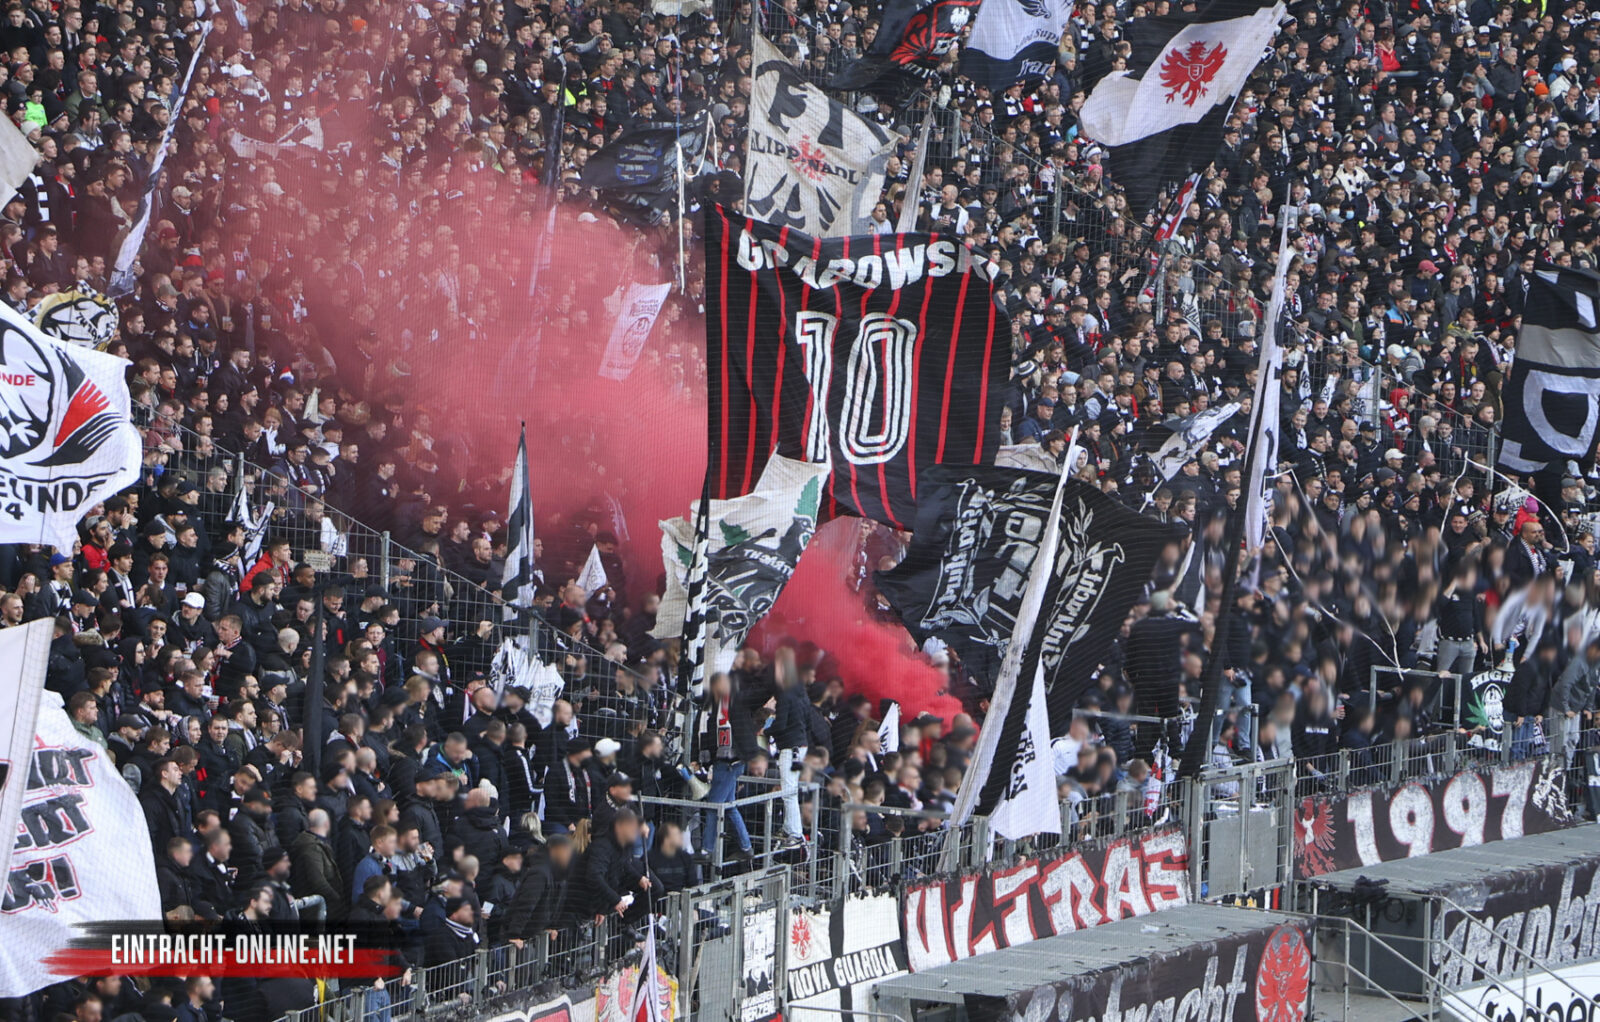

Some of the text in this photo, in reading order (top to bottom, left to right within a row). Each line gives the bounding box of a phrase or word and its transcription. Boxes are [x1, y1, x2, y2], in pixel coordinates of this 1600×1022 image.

[0, 374, 36, 386] NDE
[796, 310, 917, 465] 10
[1470, 670, 1514, 691] HIGH
[1347, 760, 1536, 867] 1997
[905, 829, 1190, 973] ULTRAS
[788, 961, 832, 1000] NOVA
[833, 944, 899, 987] GUARDIA
